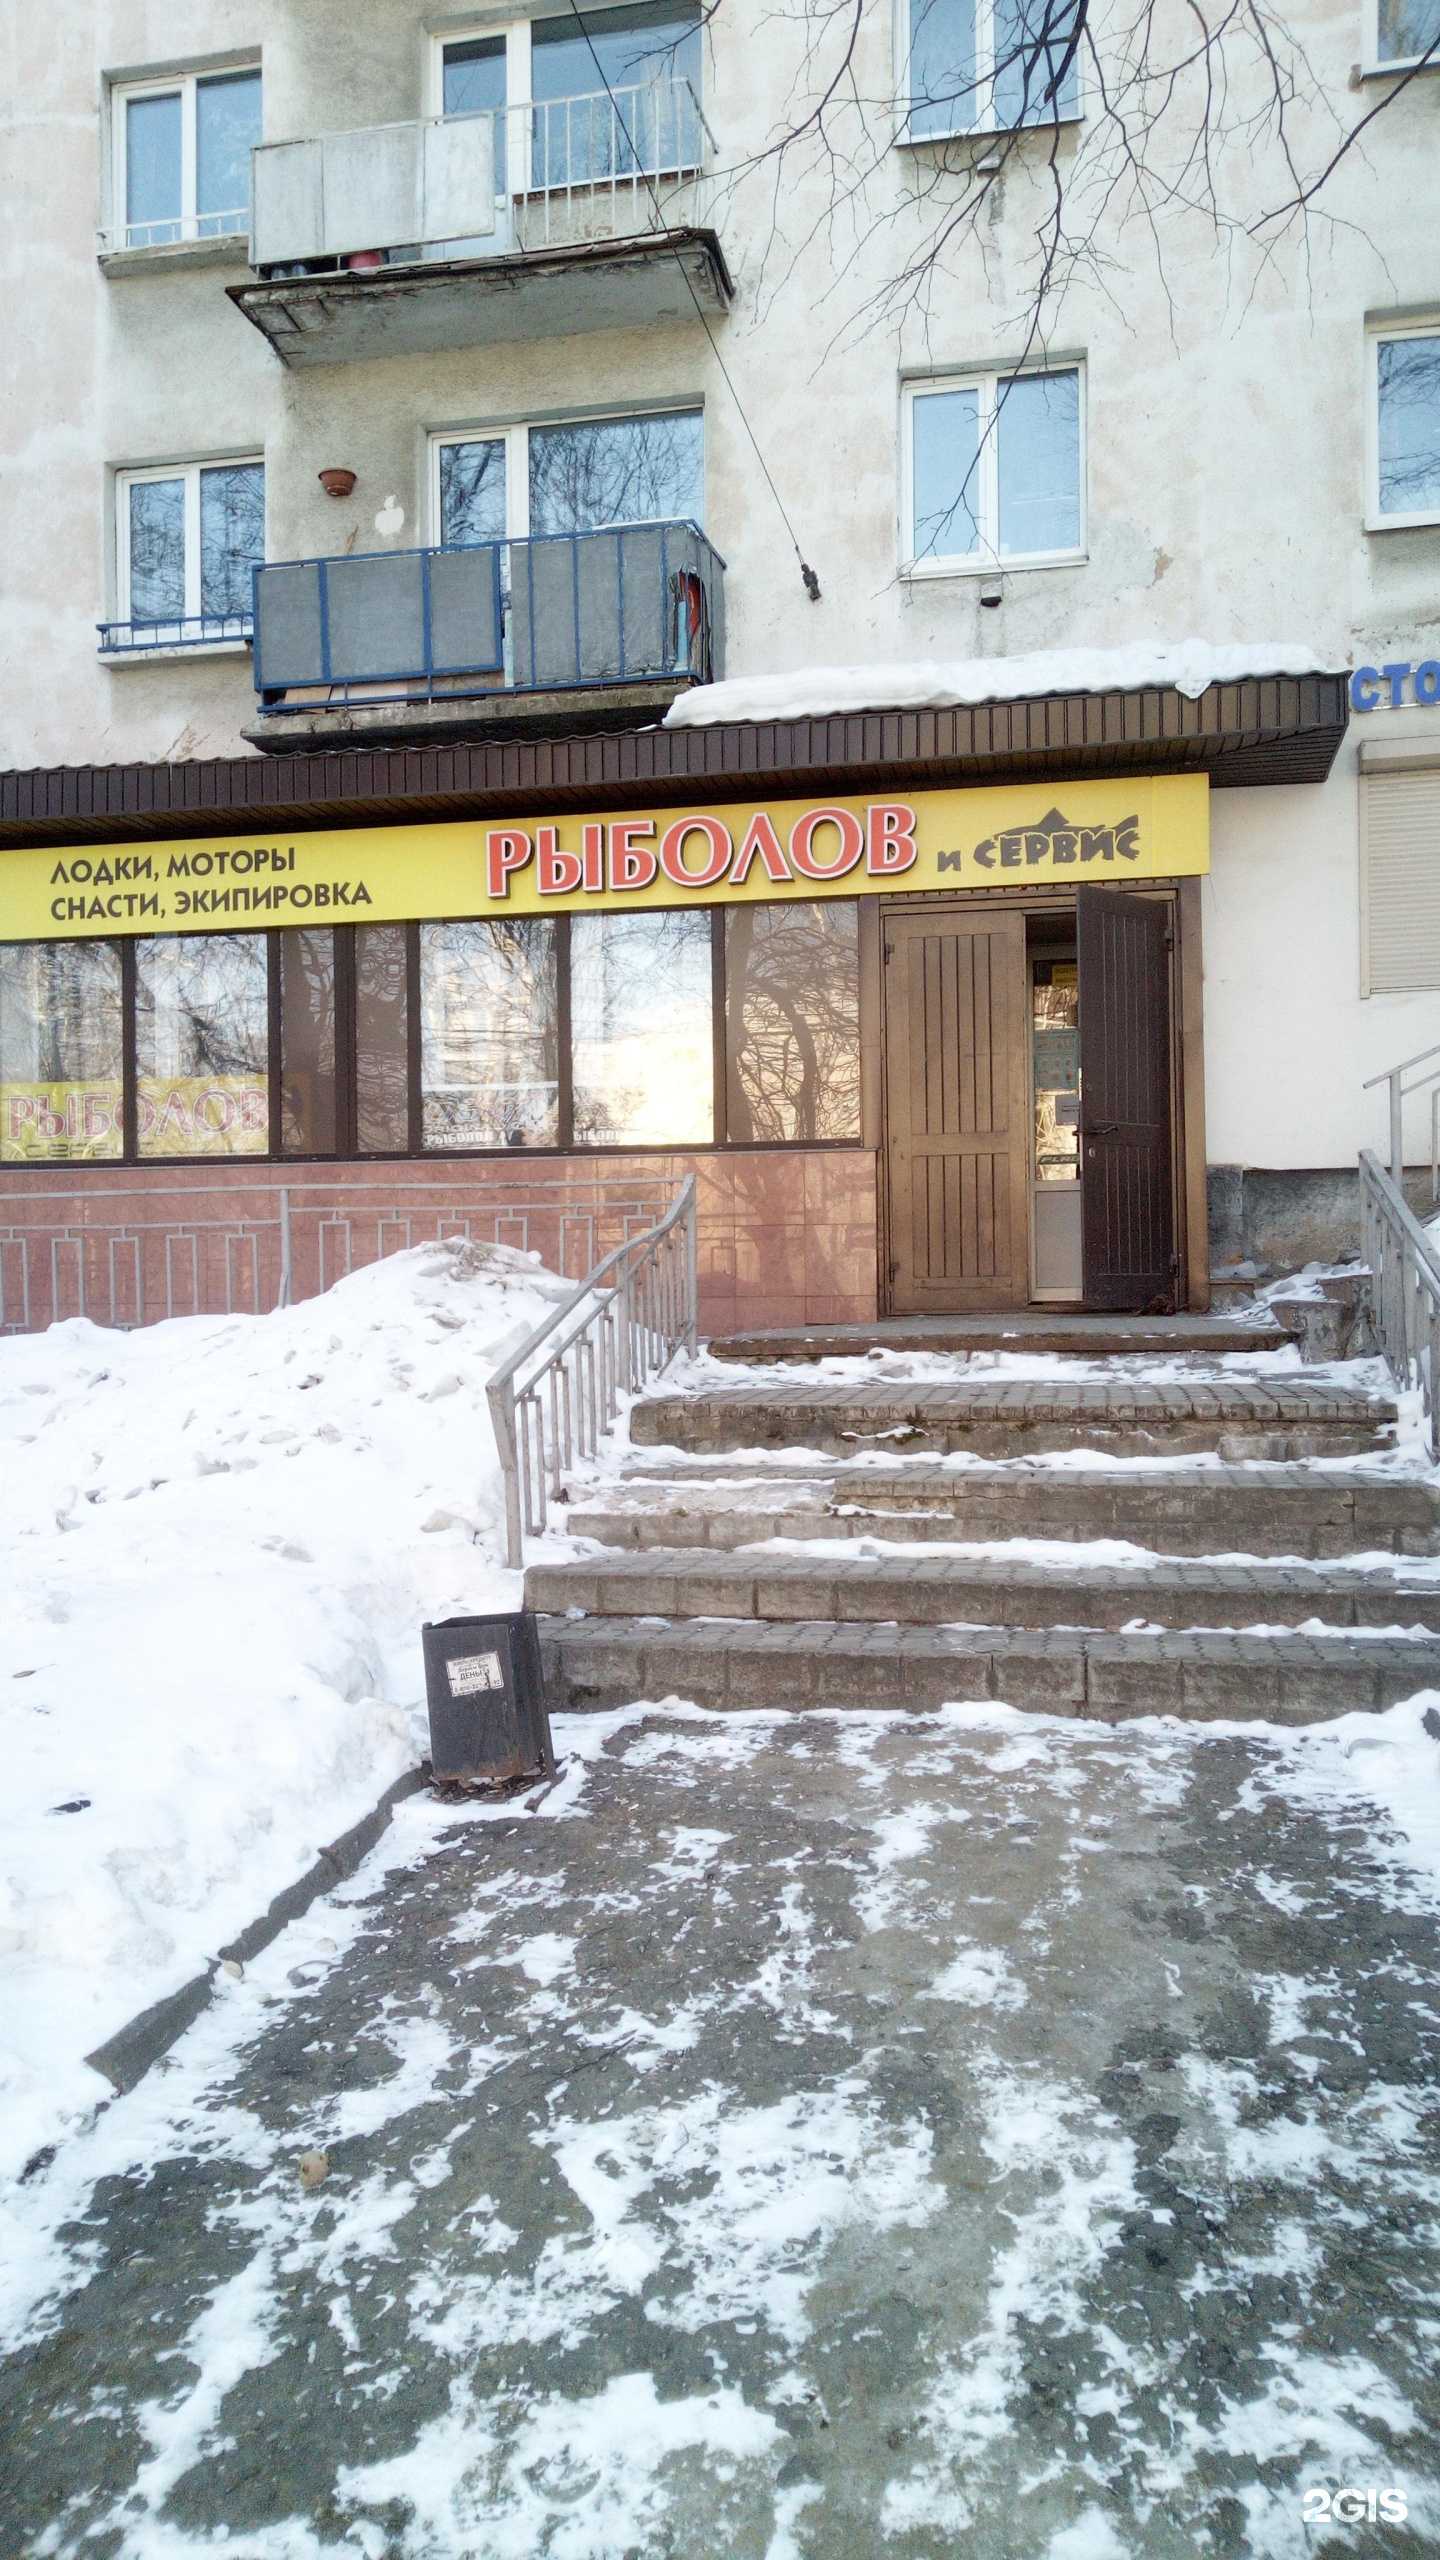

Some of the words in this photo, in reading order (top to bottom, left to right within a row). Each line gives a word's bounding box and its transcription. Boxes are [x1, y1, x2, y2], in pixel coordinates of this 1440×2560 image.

[50, 855, 160, 885] ЛОДКИ,
[166, 847, 295, 877] МОТОРЫ
[486, 804, 919, 899] РЫБОЛОВ
[973, 828, 1140, 869] СЕРВИС
[50, 892, 165, 921] СНАСТИ,
[174, 881, 373, 915] ЭКИПИРОВКА
[8, 1087, 270, 1140] РЫБОЛОВ
